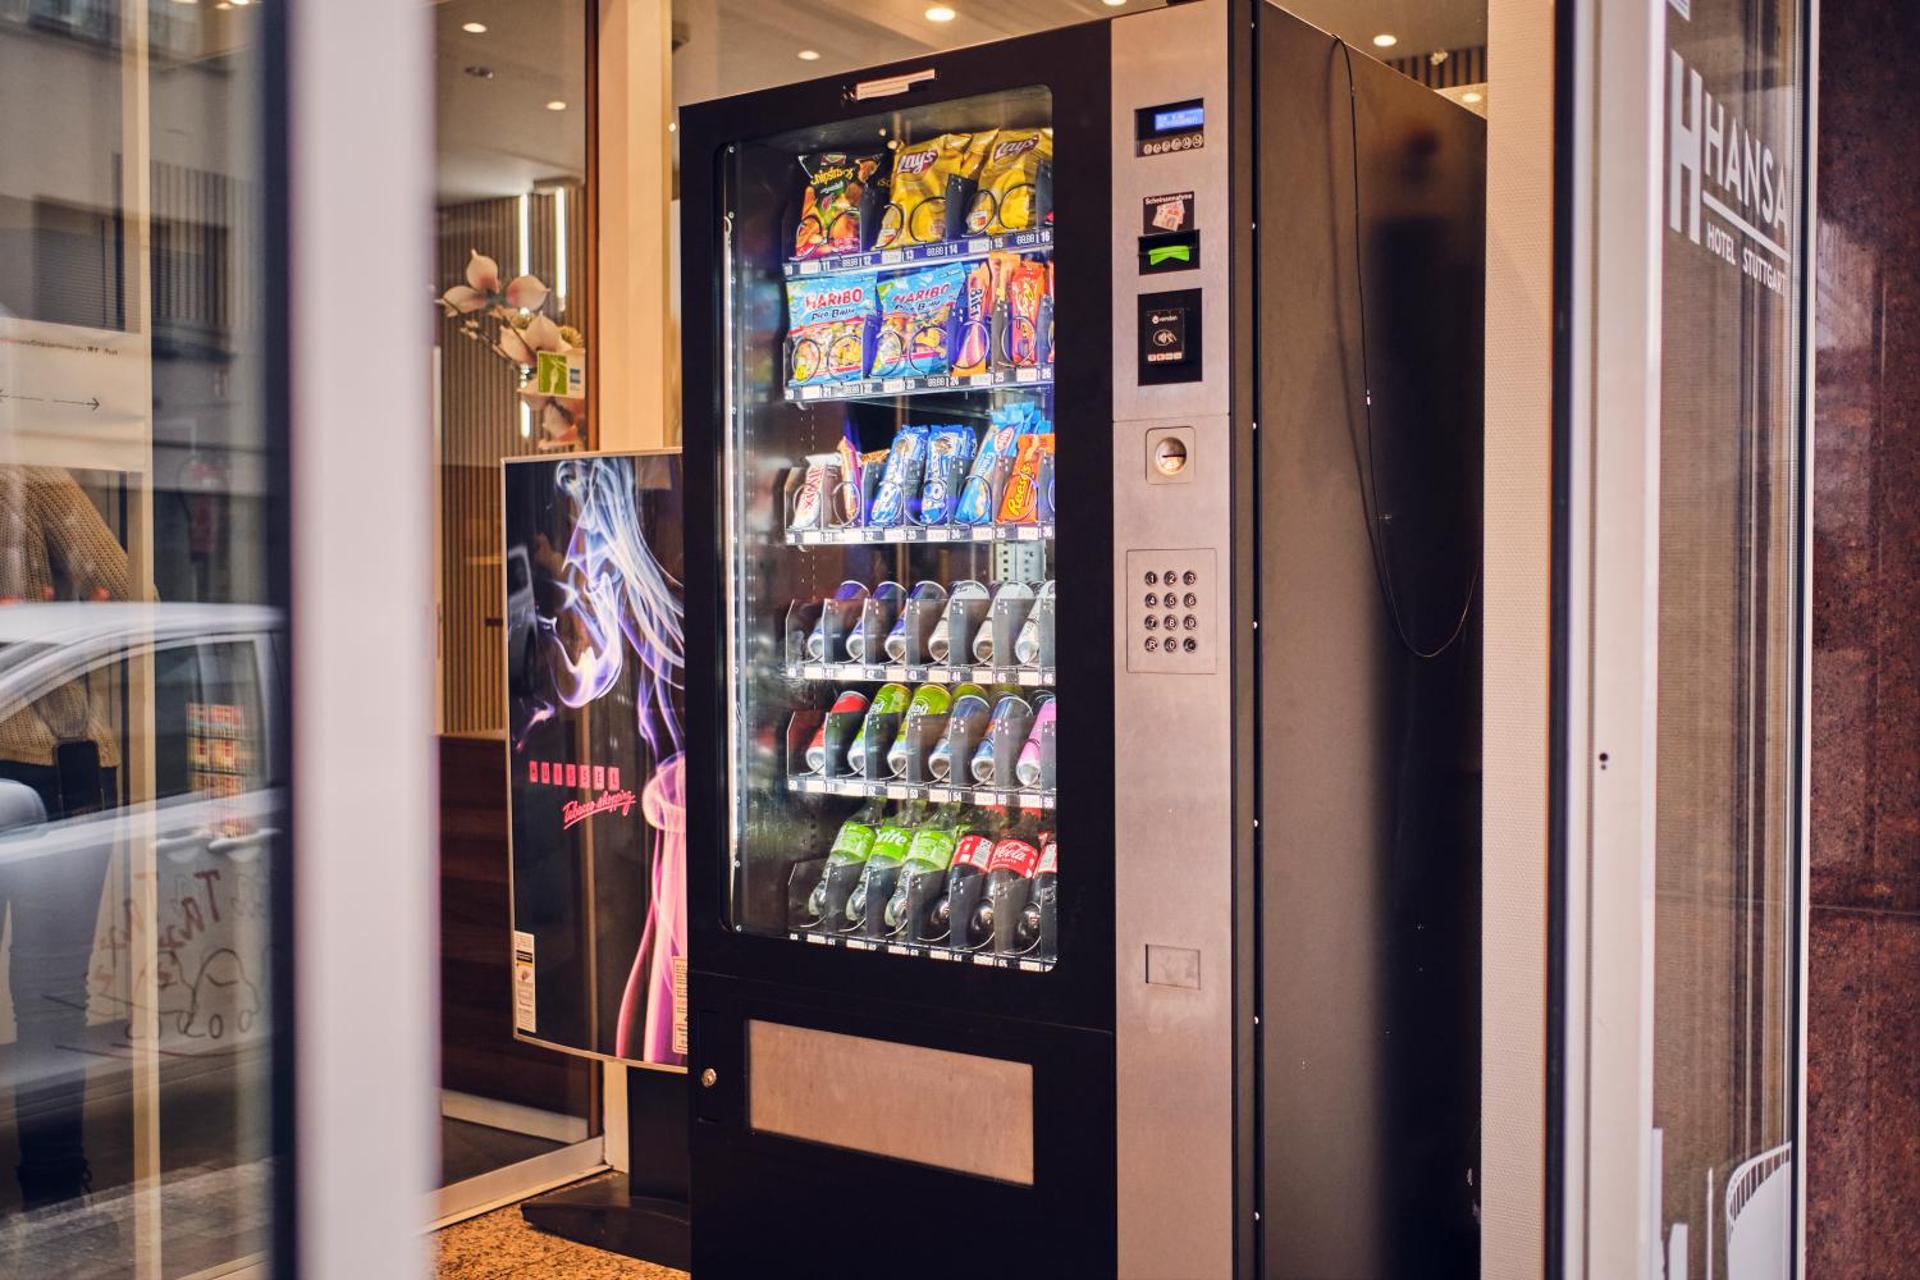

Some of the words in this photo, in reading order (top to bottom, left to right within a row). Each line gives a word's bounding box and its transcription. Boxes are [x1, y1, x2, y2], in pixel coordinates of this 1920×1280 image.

[1671, 50, 1702, 245] H
[1705, 91, 1788, 237] HANSA
[1041, 231, 1050, 243] 16
[1707, 221, 1736, 265] HOTEL
[1743, 247, 1786, 297] STUTTGART
[804, 287, 864, 311] HARIBO
